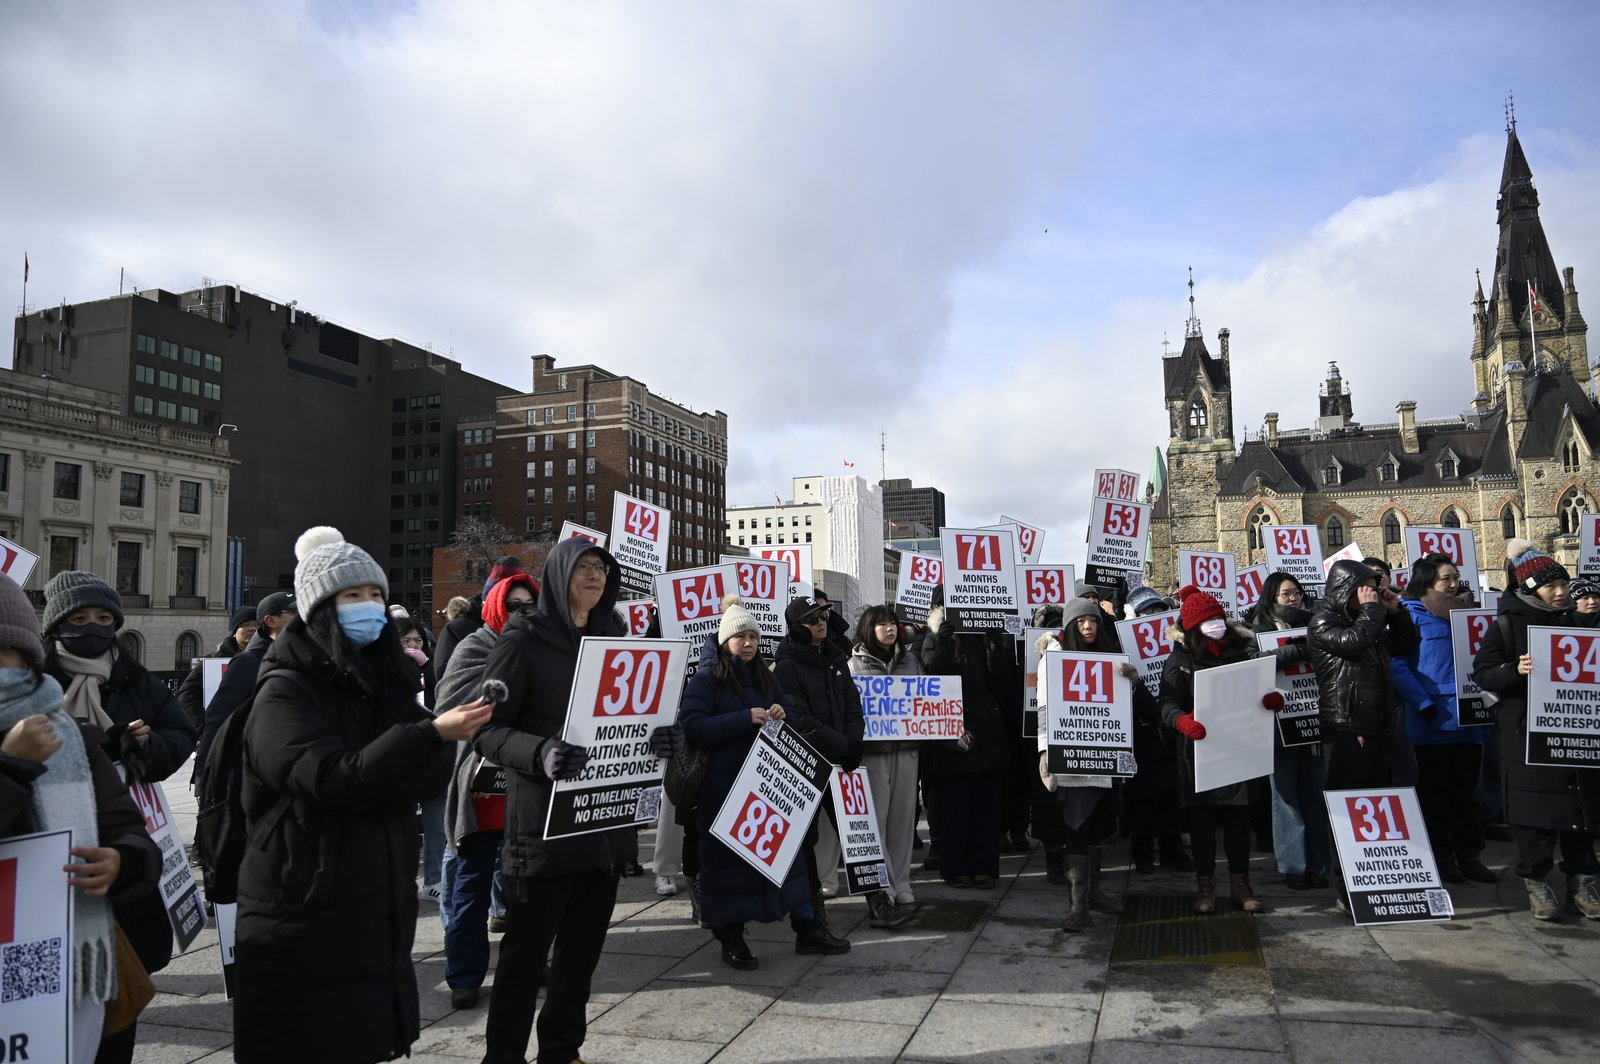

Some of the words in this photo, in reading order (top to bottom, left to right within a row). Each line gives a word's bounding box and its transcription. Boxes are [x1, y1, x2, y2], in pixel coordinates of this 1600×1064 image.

[1120, 475, 1133, 501] 31
[628, 504, 656, 540] 42
[1107, 504, 1136, 537] 53
[627, 537, 654, 551] MONTHS
[1105, 538, 1132, 548] MONTHS
[1278, 529, 1307, 555] 34
[619, 544, 646, 558] WAITING
[647, 553, 660, 563] FOR
[962, 536, 996, 570] 71
[1096, 545, 1124, 557] WAITING
[1125, 549, 1139, 558] FOR
[1424, 533, 1458, 566] 39
[614, 552, 630, 563] IRCC
[629, 556, 662, 573] RESPONSE
[1091, 554, 1107, 563] IRCC
[1108, 556, 1141, 568] RESPONSE
[914, 558, 940, 584] 39
[1105, 569, 1127, 578] TIMELIN
[1195, 557, 1222, 588] 68
[620, 576, 629, 584] NO
[629, 578, 652, 590] RESULTS
[739, 564, 772, 598] 30
[963, 574, 998, 584] MONTHS
[905, 589, 930, 599] WAITING
[912, 583, 933, 592] MONTH
[955, 584, 990, 594] WAITING
[991, 585, 1008, 594] FOR
[1031, 570, 1061, 604] 53
[679, 575, 722, 619] 54
[950, 595, 970, 604] IRCC
[970, 595, 1013, 605] RESPONSE
[743, 602, 770, 612] ONTHS
[763, 614, 778, 622] FOR
[959, 611, 970, 619] NO
[971, 611, 1006, 619] TIMELINES
[974, 620, 1003, 628] RESULTS
[1138, 618, 1174, 657] 34
[1556, 636, 1600, 683] 34
[603, 651, 661, 715] 30
[901, 677, 940, 696] THE
[1068, 660, 1108, 702] 41
[1285, 689, 1320, 702] WAITIN
[1069, 706, 1110, 717] MONTHS
[1283, 703, 1304, 714] IRCC
[1472, 701, 1481, 709] NO
[1544, 702, 1592, 715] WAITING
[1476, 711, 1485, 719] NO
[1059, 718, 1100, 729] WAITING
[1102, 720, 1121, 730] FOR
[1295, 719, 1308, 729] NO
[1536, 716, 1561, 728] IRCC
[1563, 717, 1600, 730] RESPO
[595, 723, 648, 741] MONTHS
[1053, 730, 1075, 741] IRCC
[1076, 731, 1127, 743] RESPONSE
[1301, 728, 1314, 738] NO
[780, 730, 808, 758] RESULTS
[1547, 737, 1561, 746] NO
[1562, 737, 1600, 748] TIMELIN
[773, 739, 806, 769] TIMELINES
[1063, 749, 1075, 758] NO
[1076, 749, 1117, 759] TIMELINES
[1551, 748, 1565, 758] NO
[1566, 749, 1600, 759] RESULT
[757, 746, 798, 788] RESPONSE
[807, 755, 818, 767] NO
[1066, 760, 1078, 769] NO
[1079, 760, 1114, 769] RESULTS
[596, 759, 659, 780] RESPONSE
[756, 762, 773, 779] FOR
[804, 767, 816, 779] NO
[573, 795, 590, 808] NO
[591, 787, 643, 805] TIMELINES
[759, 782, 793, 816] MONTHS
[773, 777, 806, 811] WAITING
[797, 782, 817, 802] IRCC
[842, 773, 866, 814] 36
[575, 811, 591, 824] NO
[592, 804, 636, 821] RESULTS
[1355, 796, 1403, 841] 31
[737, 800, 784, 859] 38
[849, 821, 869, 831] MONTHS
[847, 834, 867, 844] WAITING
[867, 833, 876, 843] FOR
[846, 848, 857, 858] IRCC
[857, 845, 881, 856] RESPONSE
[1363, 845, 1408, 858] MONTHS
[854, 867, 860, 875] NO
[1355, 860, 1400, 872] WAITING
[1401, 858, 1423, 869] FOR
[857, 877, 863, 886] NO
[1352, 875, 1377, 886] IRCC
[1378, 872, 1433, 885] RESPONSE
[1368, 895, 1380, 904] NO
[1380, 892, 1427, 904] TIMELINES
[1374, 907, 1387, 916] NO
[1389, 904, 1427, 915] RESULTS
